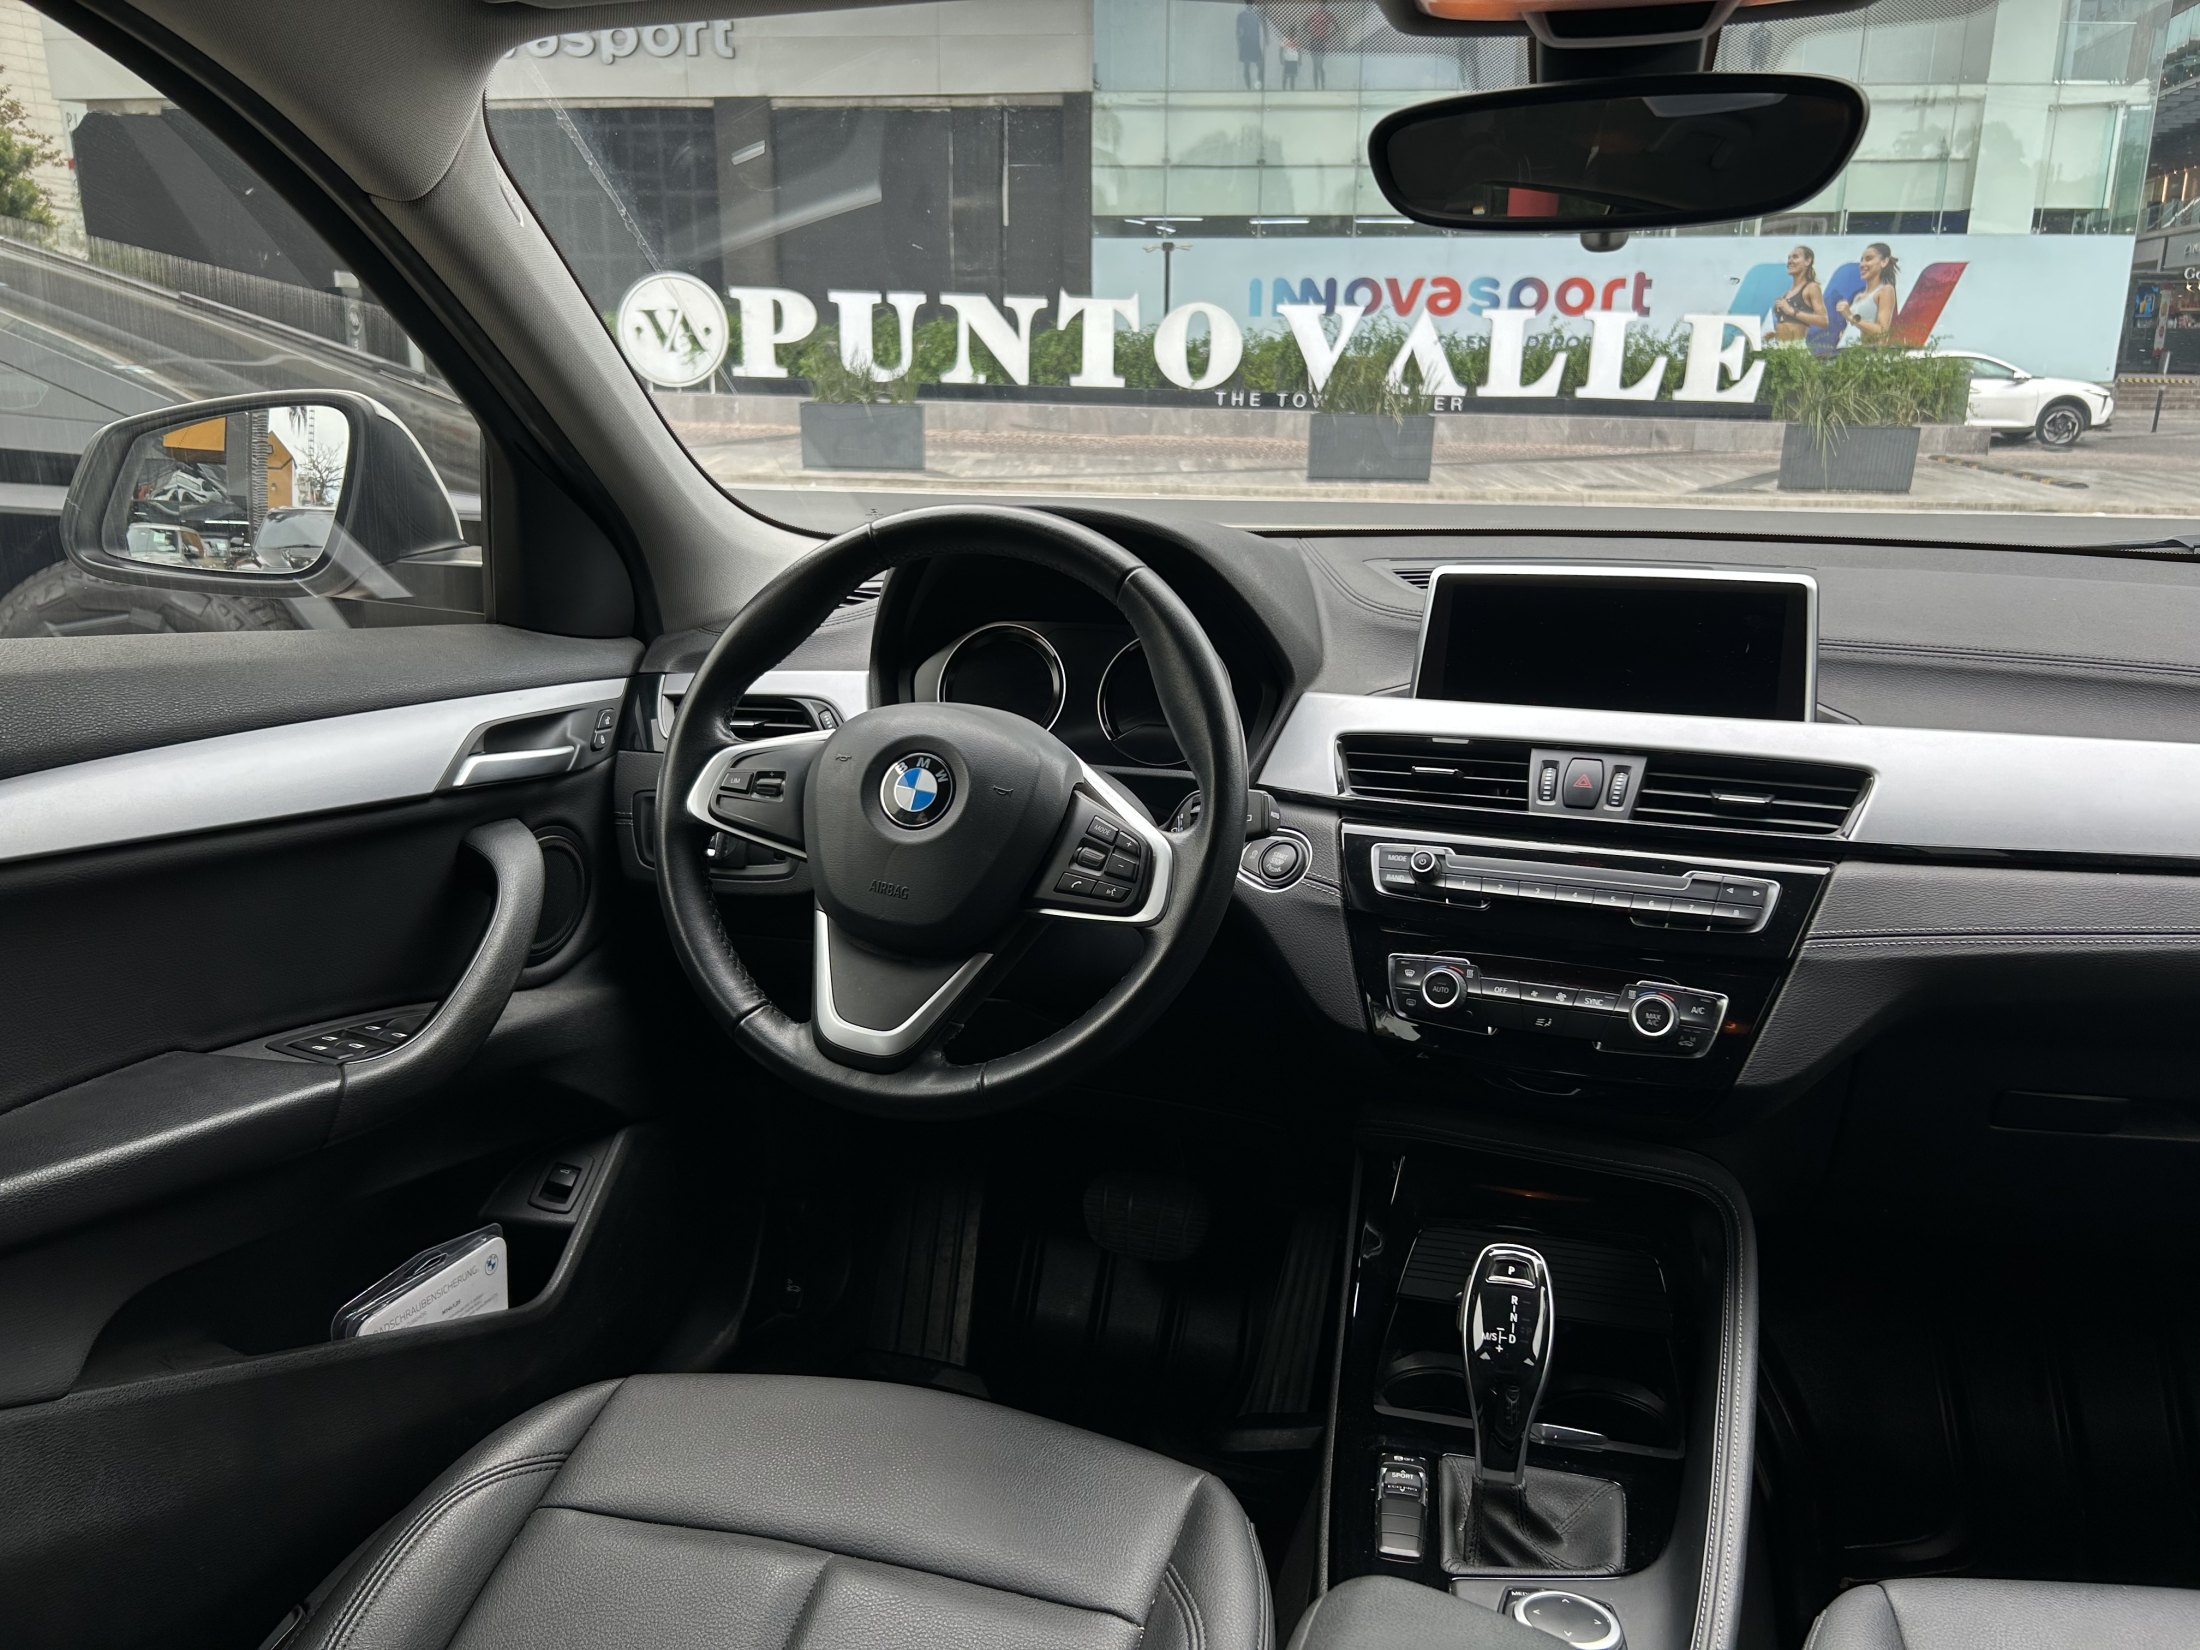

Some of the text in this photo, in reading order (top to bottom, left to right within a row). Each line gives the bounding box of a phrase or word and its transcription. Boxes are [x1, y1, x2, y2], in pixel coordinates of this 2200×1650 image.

[728, 286, 1767, 403] PUNTO VALLE
[1215, 390, 1261, 407] THE
[894, 756, 949, 784] BMW
[1094, 824, 1111, 836] MODE
[1387, 854, 1407, 863] MODE
[1385, 873, 1405, 882] BAND
[869, 880, 910, 900] AIRBAG
[1432, 985, 1450, 994] AUTO
[1493, 986, 1508, 994] OFF
[1584, 997, 1604, 1006] SYNC
[1690, 1006, 1705, 1015] A/C
[1645, 1012, 1662, 1021] MAX
[1508, 1265, 1516, 1275] P
[1511, 1295, 1518, 1305] R
[1510, 1312, 1518, 1323] N
[1508, 1333, 1517, 1344] D
[1391, 1472, 1414, 1480] SPORT
